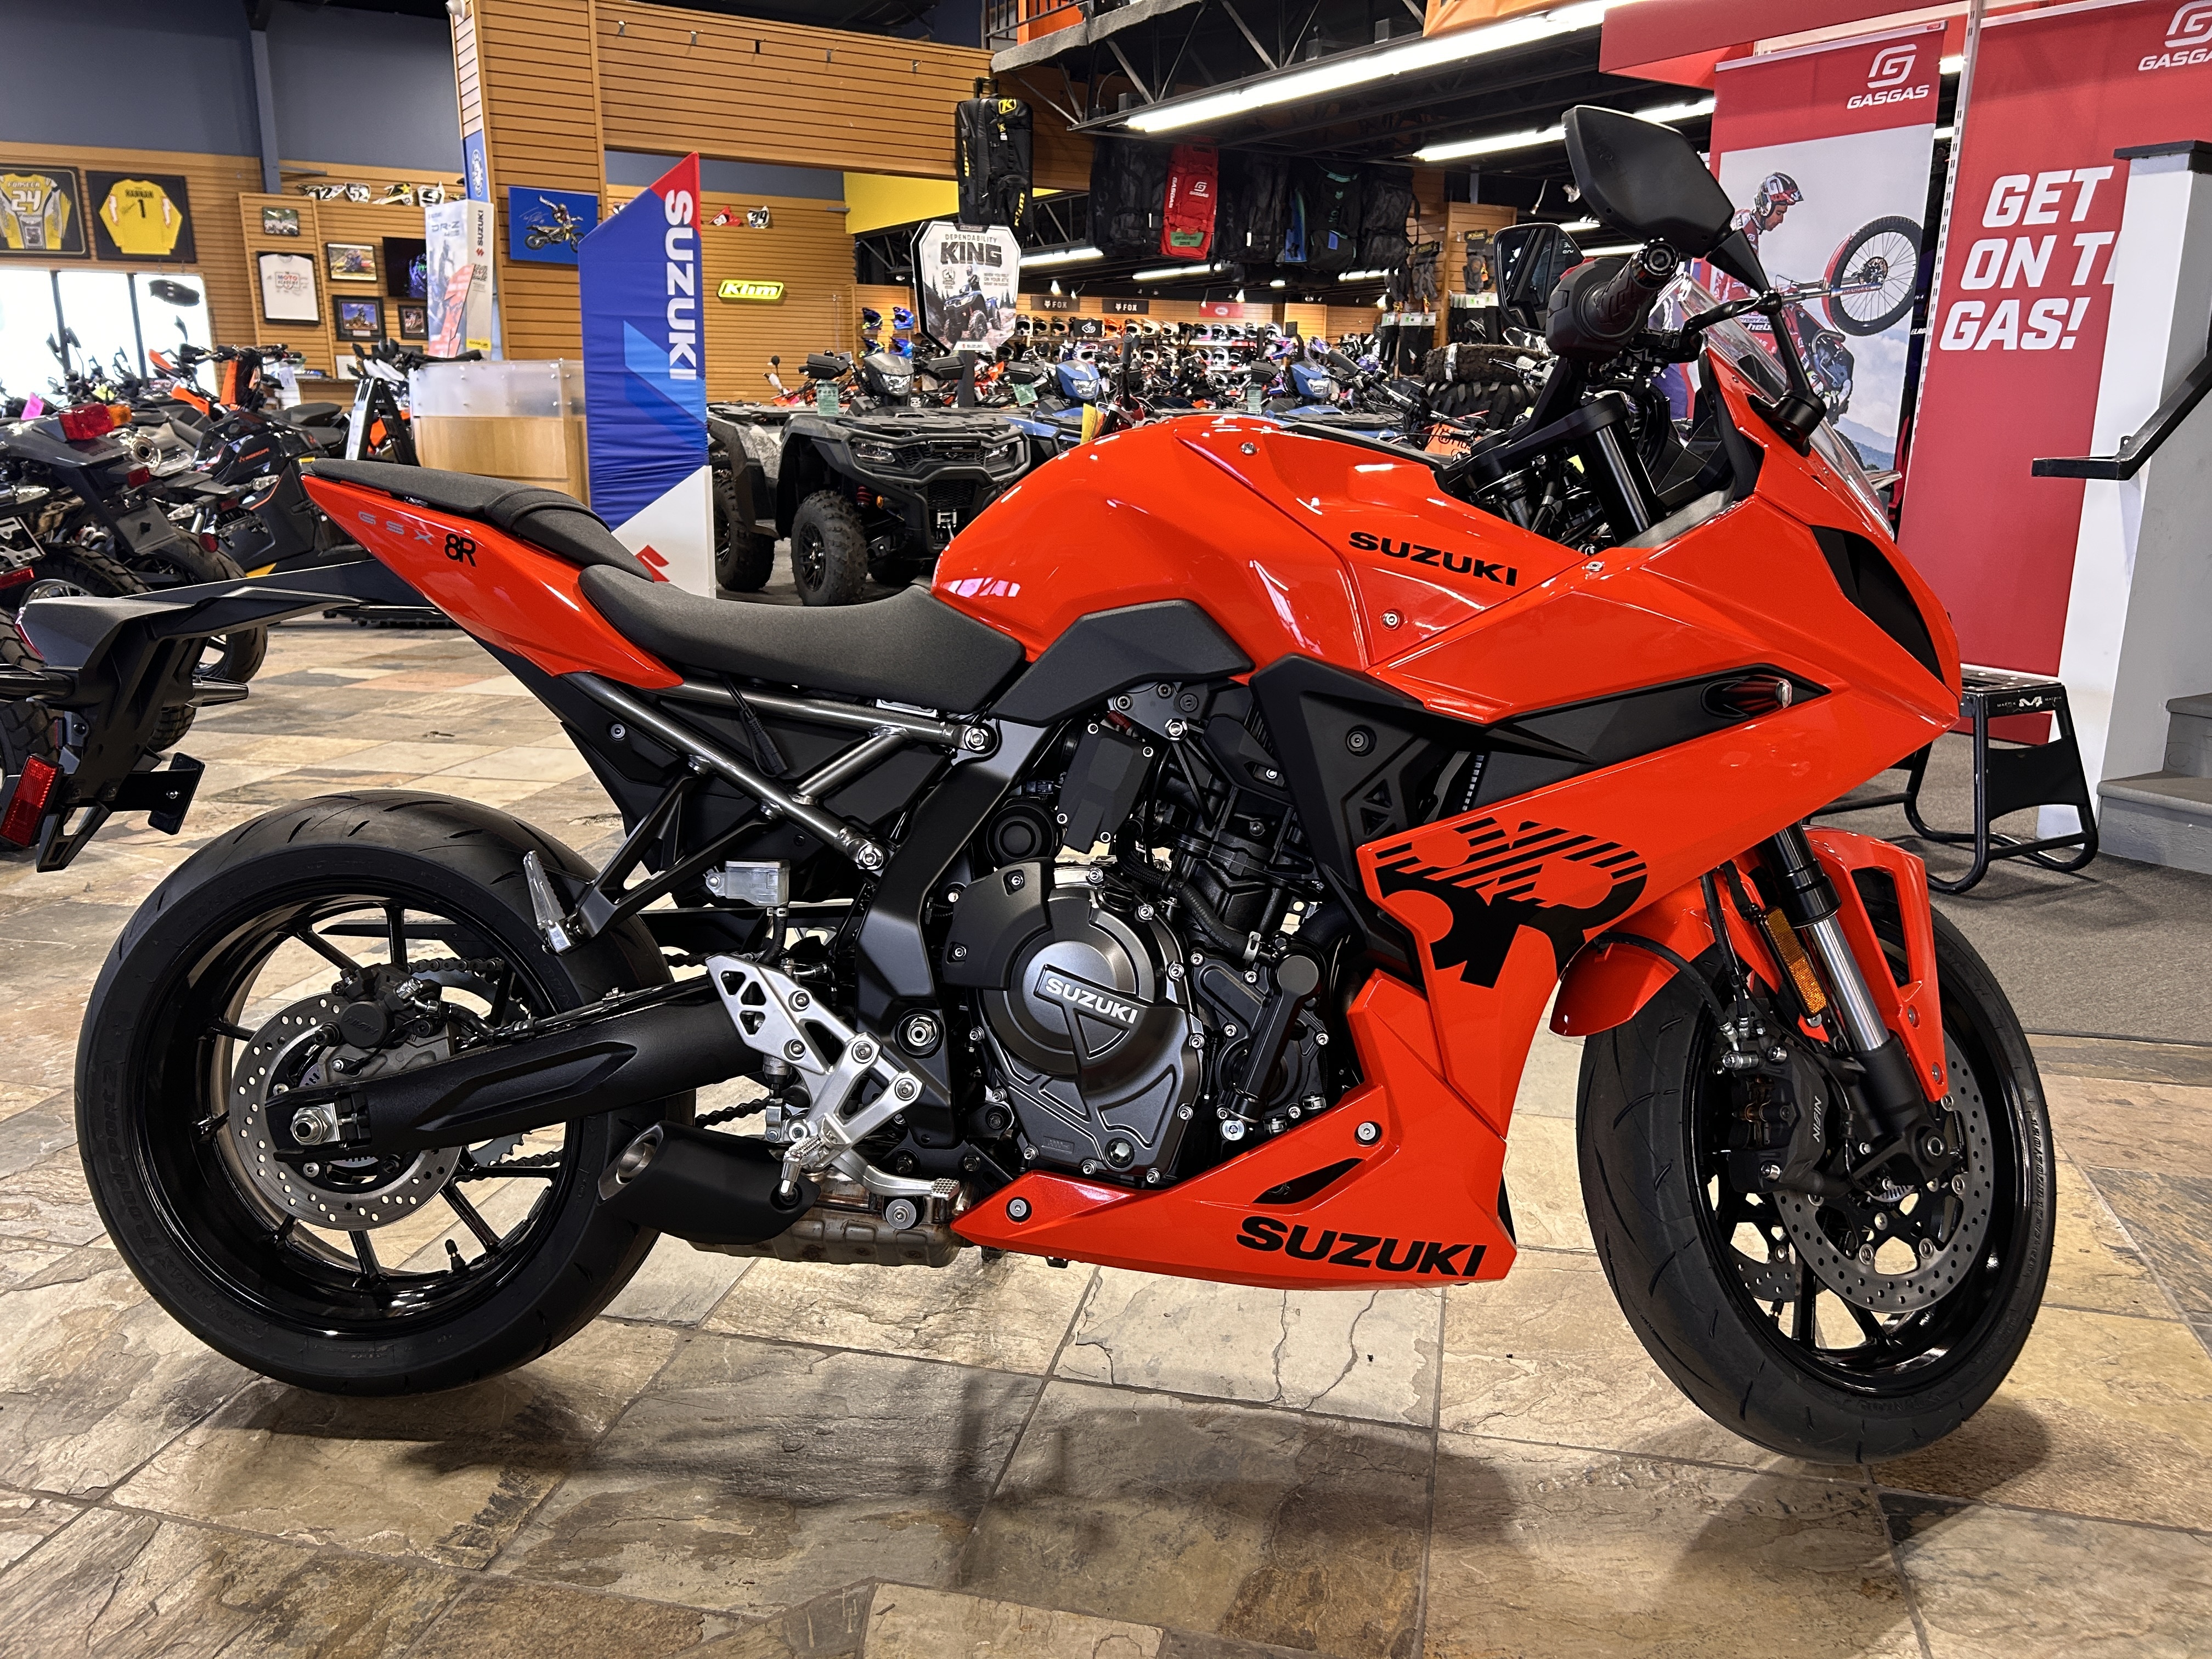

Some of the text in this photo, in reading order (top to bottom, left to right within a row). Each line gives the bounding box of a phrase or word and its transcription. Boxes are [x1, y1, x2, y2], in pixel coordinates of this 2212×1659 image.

[1847, 84, 1929, 109] GASGAS
[12, 190, 42, 211] 24
[138, 199, 146, 218] 1
[1982, 166, 2114, 228] GET
[940, 241, 1002, 268] KING
[945, 234, 997, 244] DEPENDABILITY
[1960, 234, 2057, 290] ON
[664, 189, 696, 380] SUZUKI
[723, 283, 778, 296] Klim
[1939, 297, 2091, 351] GAS!
[443, 533, 477, 567] 8R
[1348, 531, 1518, 587] SUZUKI
[1045, 977, 1139, 1024] SUZUKI
[1812, 1095, 1822, 1142] NISSIN
[1235, 1215, 1488, 1277] SUZUKI
